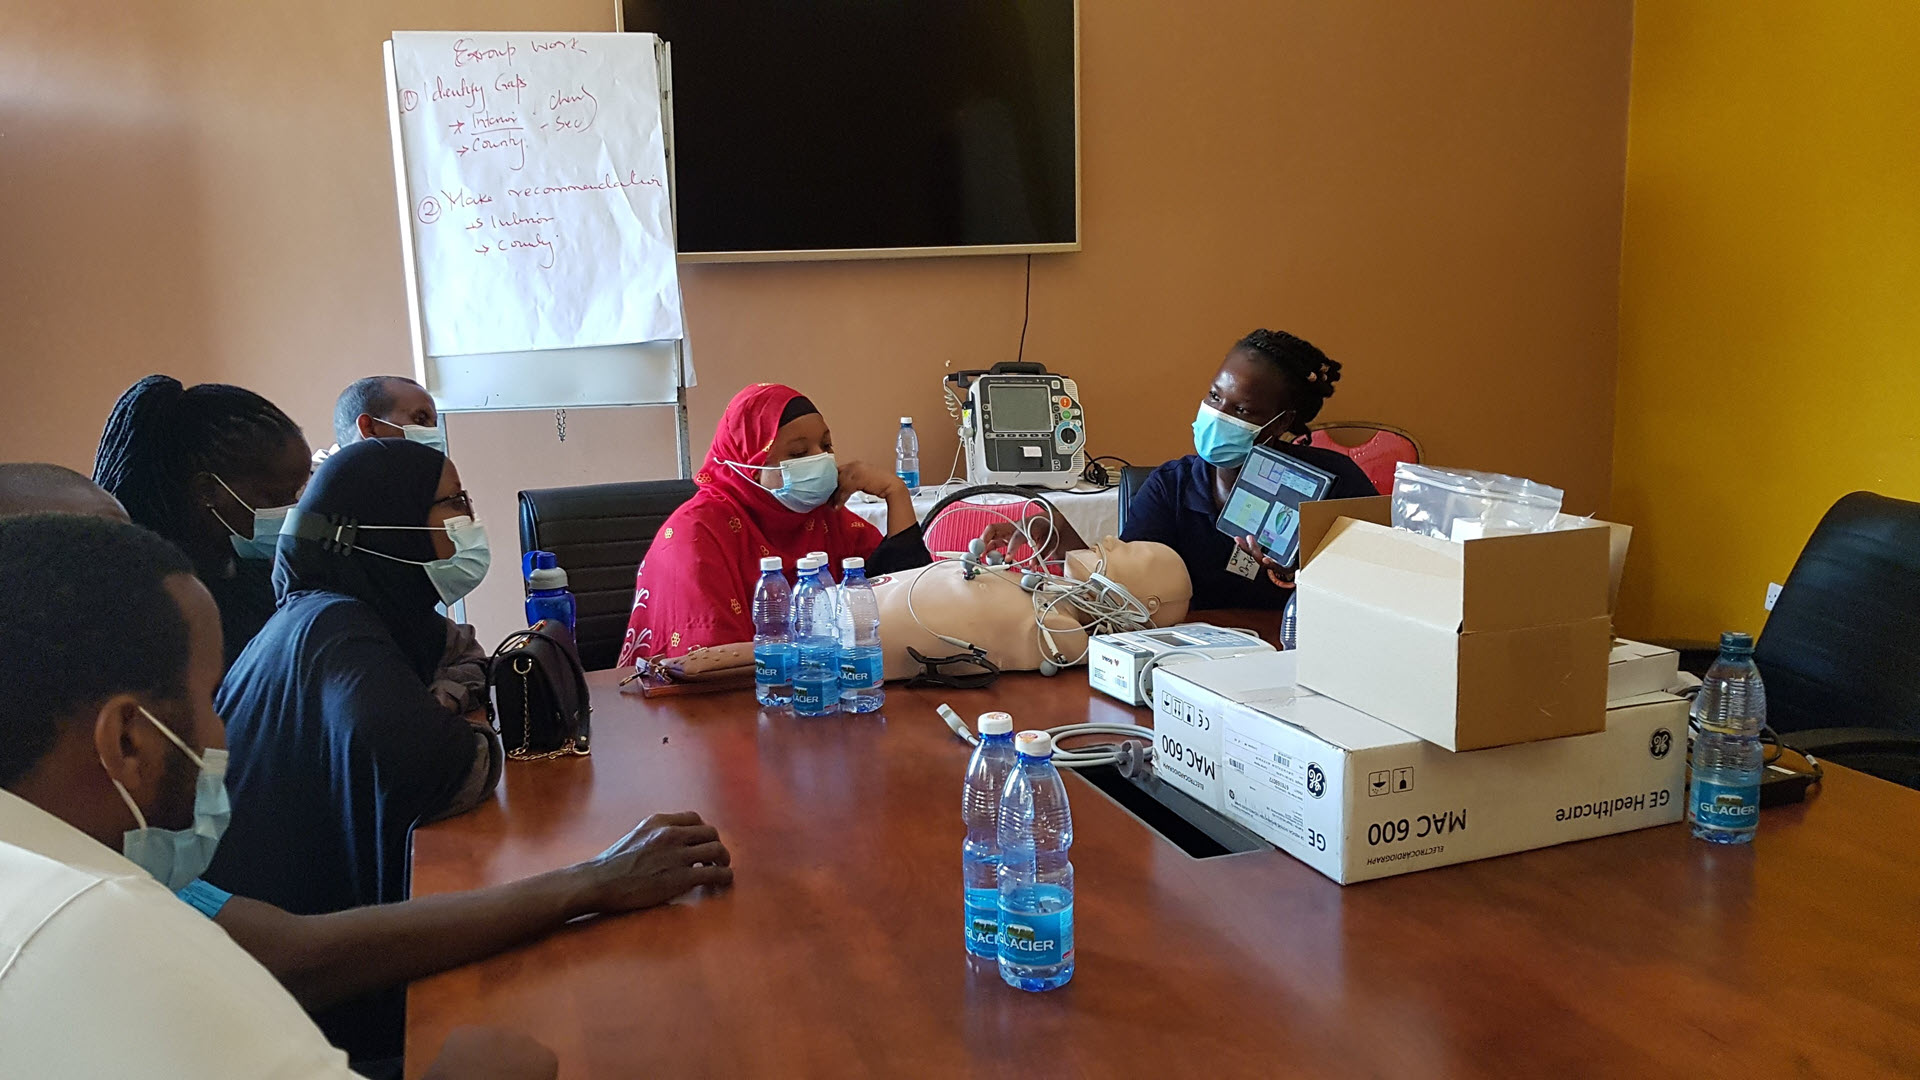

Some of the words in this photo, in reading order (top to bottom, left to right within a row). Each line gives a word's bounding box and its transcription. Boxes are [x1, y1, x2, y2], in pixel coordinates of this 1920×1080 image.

[756, 668, 778, 676] ACIER
[1162, 734, 1183, 762] 600
[1186, 747, 1216, 780] MAC
[1555, 793, 1646, 822] Healthcare
[1650, 789, 1670, 808] GE
[1700, 802, 1755, 816] GLACIER
[1367, 818, 1410, 846] 600
[1416, 808, 1467, 838] MAC
[1308, 828, 1327, 852] GE
[1366, 845, 1445, 866] ELECTROCARDIOGRAPH
[999, 931, 1054, 951] GLACIER
